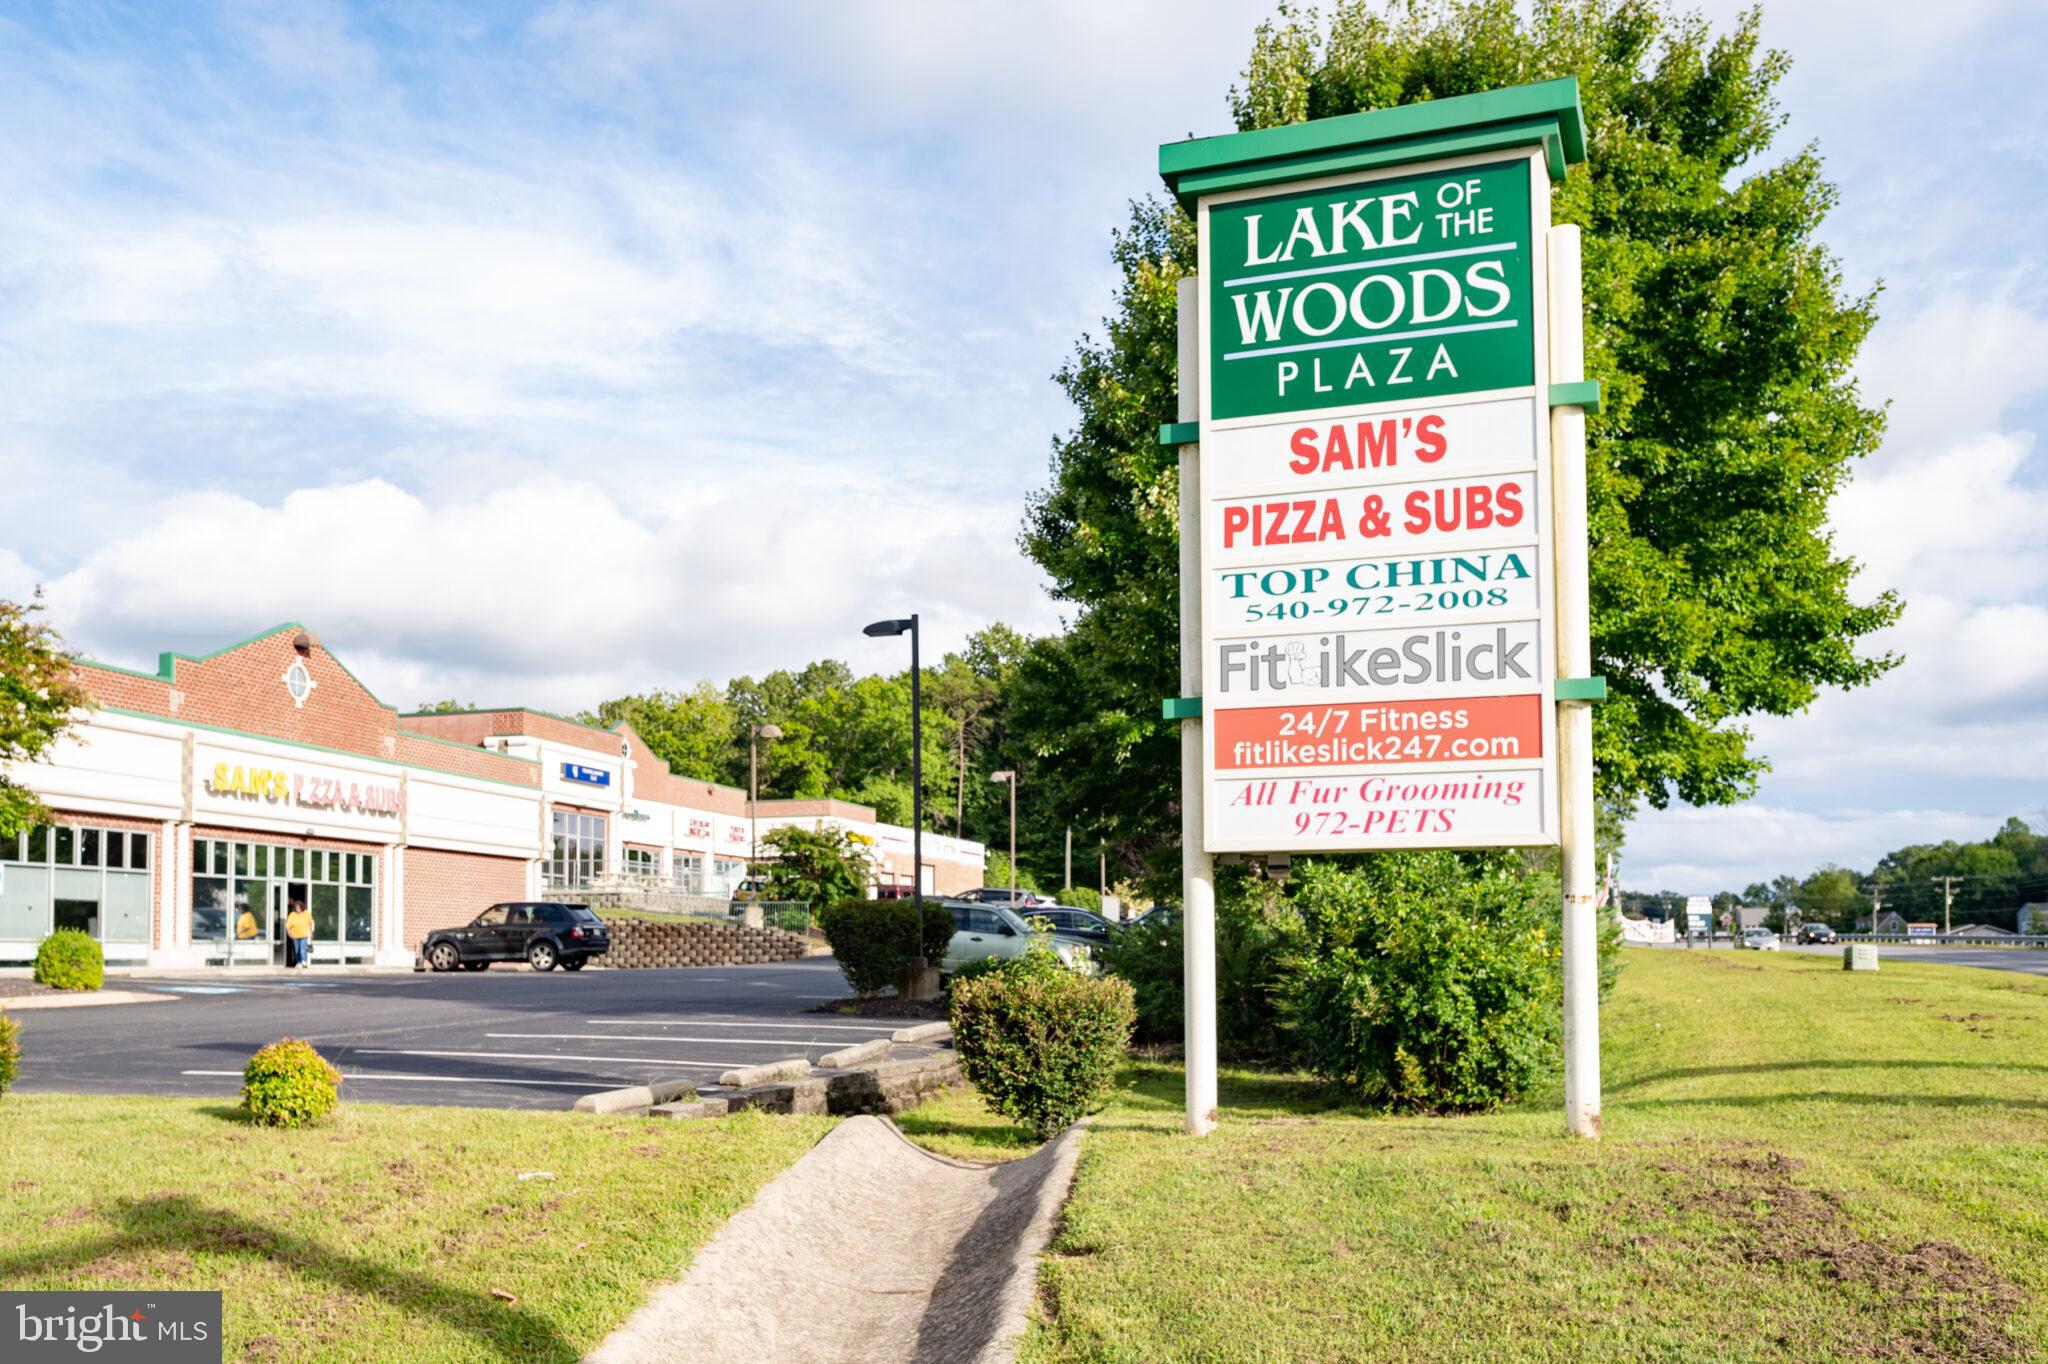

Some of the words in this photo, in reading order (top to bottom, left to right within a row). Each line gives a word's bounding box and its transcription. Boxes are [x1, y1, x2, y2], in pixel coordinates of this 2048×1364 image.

[1437, 179, 1482, 209] OF
[1244, 190, 1424, 268] LAKE
[1436, 207, 1493, 239] THE
[1230, 260, 1511, 345] WOODS
[1278, 343, 1459, 396] PLAZA
[1289, 414, 1447, 475] SAM'S
[1223, 498, 1345, 549] PIZZA
[1359, 494, 1391, 539] &
[1404, 482, 1524, 535] SUBS
[1221, 567, 1328, 599] TOP
[1347, 553, 1531, 589] CHINA
[1246, 587, 1509, 623] 540-972-2008
[1279, 708, 1349, 739] 24/7
[1361, 706, 1469, 733] Fitness
[1234, 732, 1520, 767] fitlikeslick247.com
[213, 762, 288, 798] SAM'S
[293, 774, 344, 807] PZZA
[365, 785, 406, 812] SUBS
[1231, 780, 1278, 807] All
[1289, 779, 1348, 806] Fur
[1360, 775, 1526, 806] Grooming
[1294, 808, 1456, 836] 972-PETS
